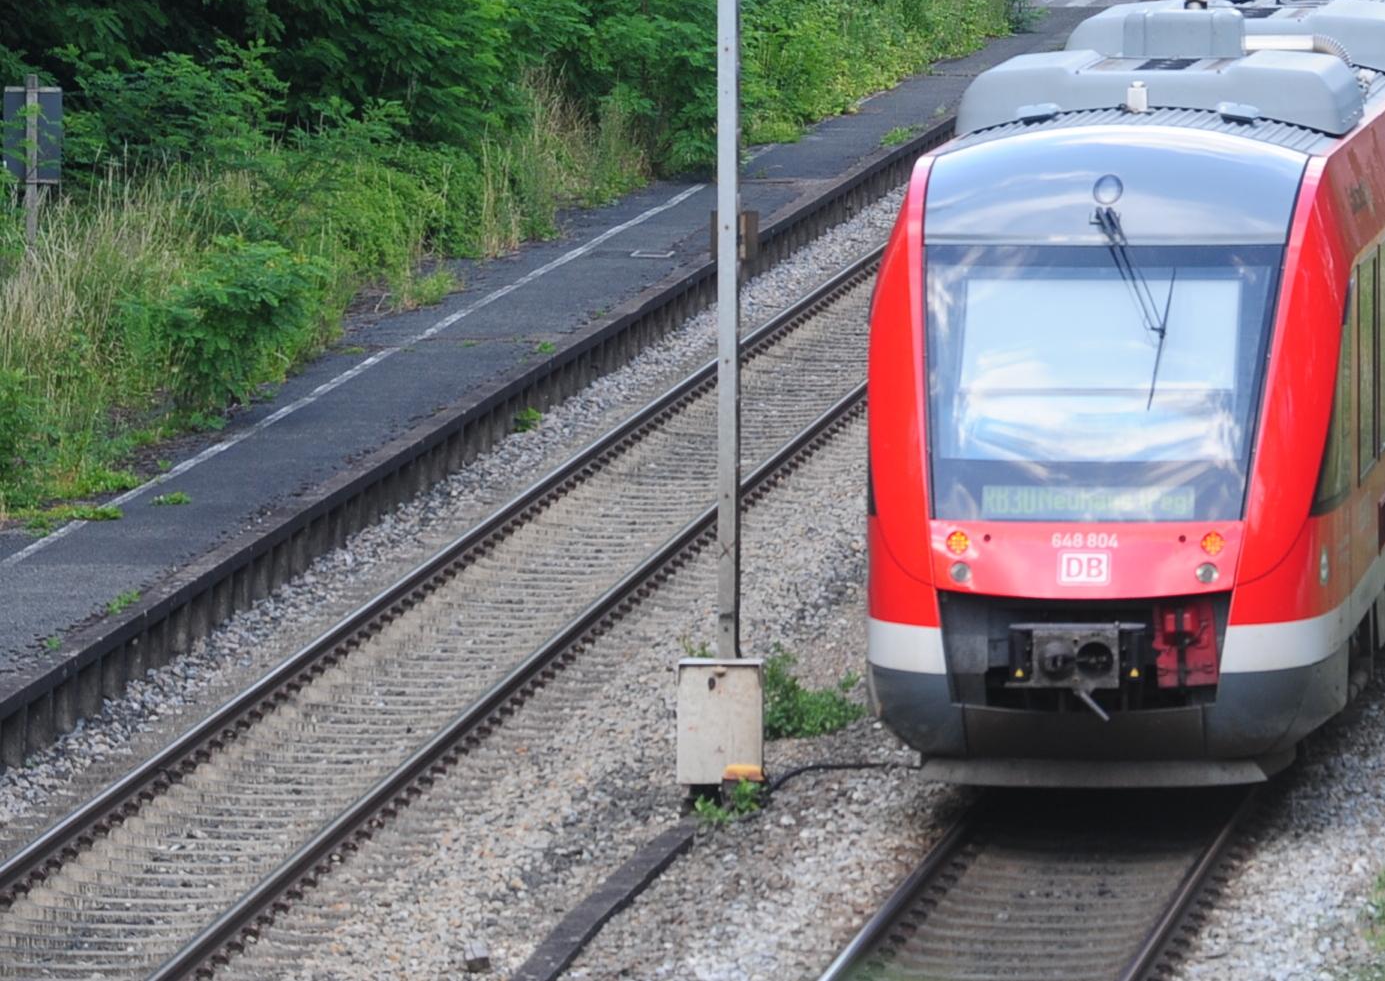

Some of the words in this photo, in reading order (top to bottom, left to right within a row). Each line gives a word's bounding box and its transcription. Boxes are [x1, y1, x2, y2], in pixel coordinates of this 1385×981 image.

[1051, 532, 1083, 548] 648
[1087, 532, 1118, 548] 804
[1065, 556, 1104, 578] DB
